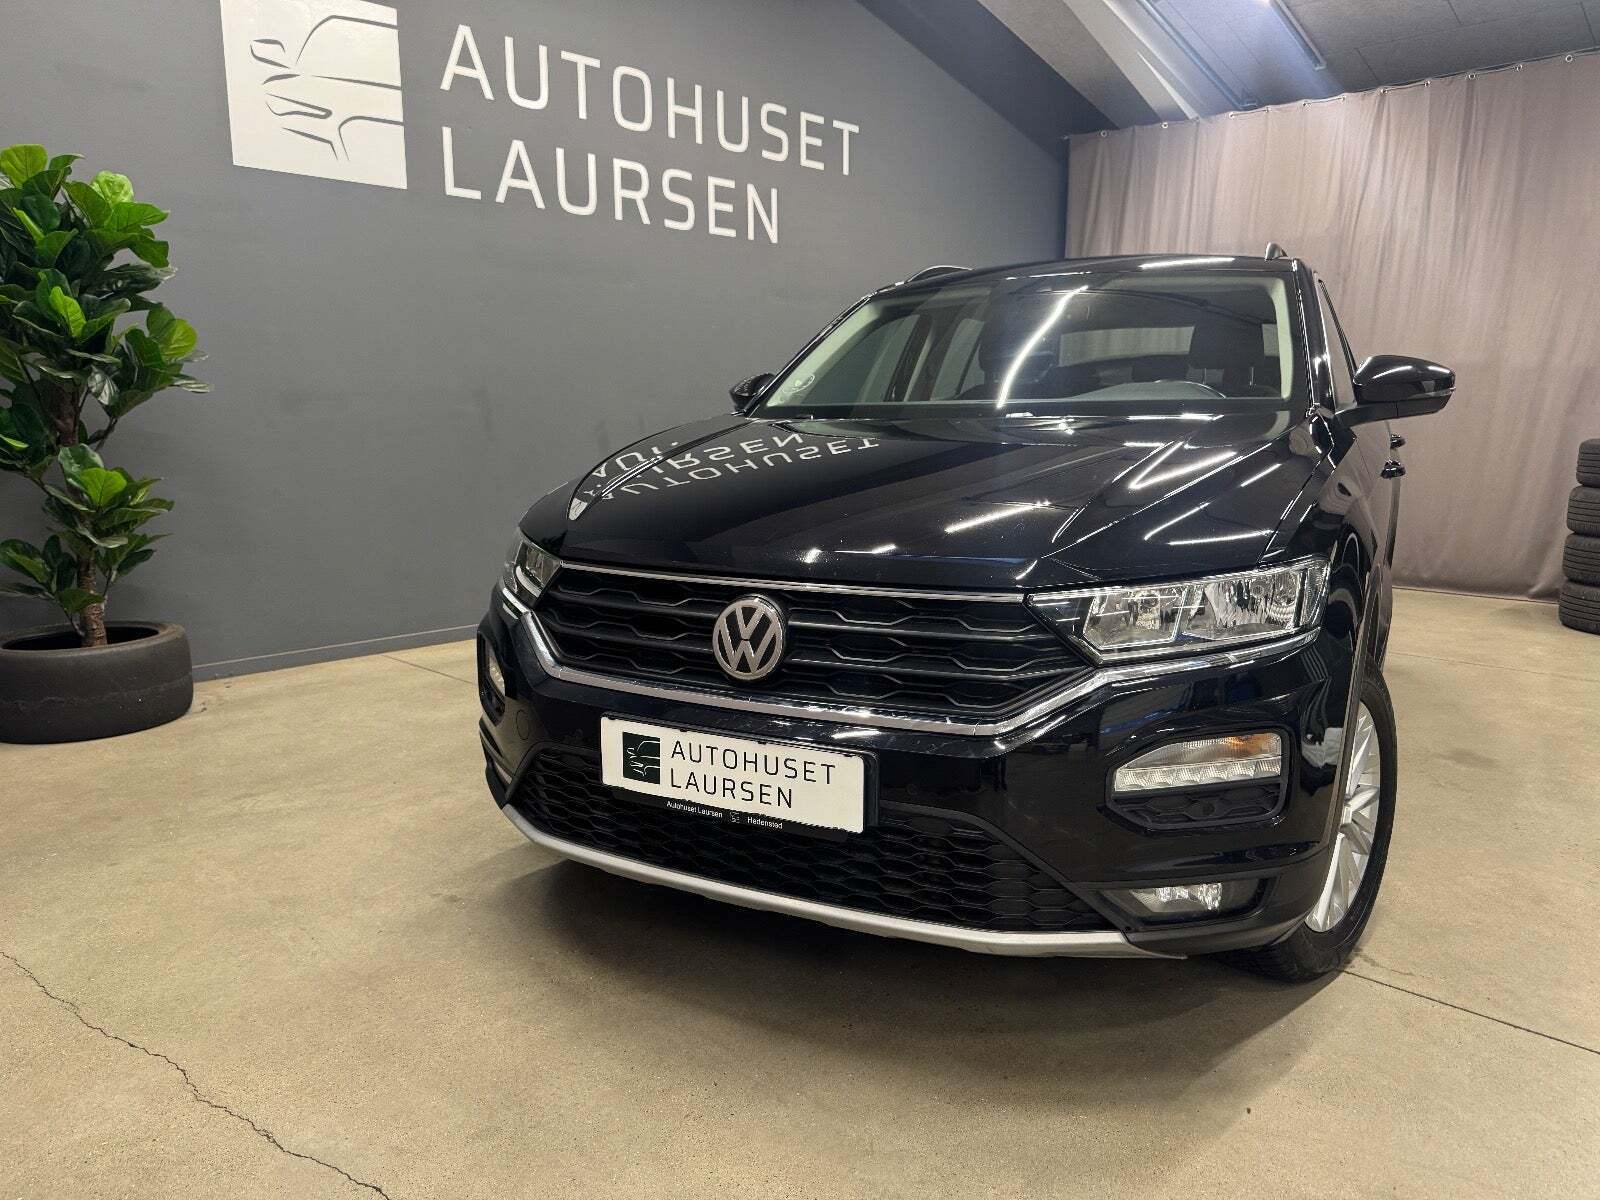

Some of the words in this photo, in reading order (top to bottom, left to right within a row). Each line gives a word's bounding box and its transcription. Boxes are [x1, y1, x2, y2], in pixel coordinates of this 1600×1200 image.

[440, 24, 860, 176] AUTOHUSET
[441, 127, 779, 244] LAURSEN
[671, 740, 836, 785] AUTOHUSET
[666, 800, 697, 813] Autohuset
[697, 807, 723, 819] Laursen
[670, 768, 793, 809] LAURSEN
